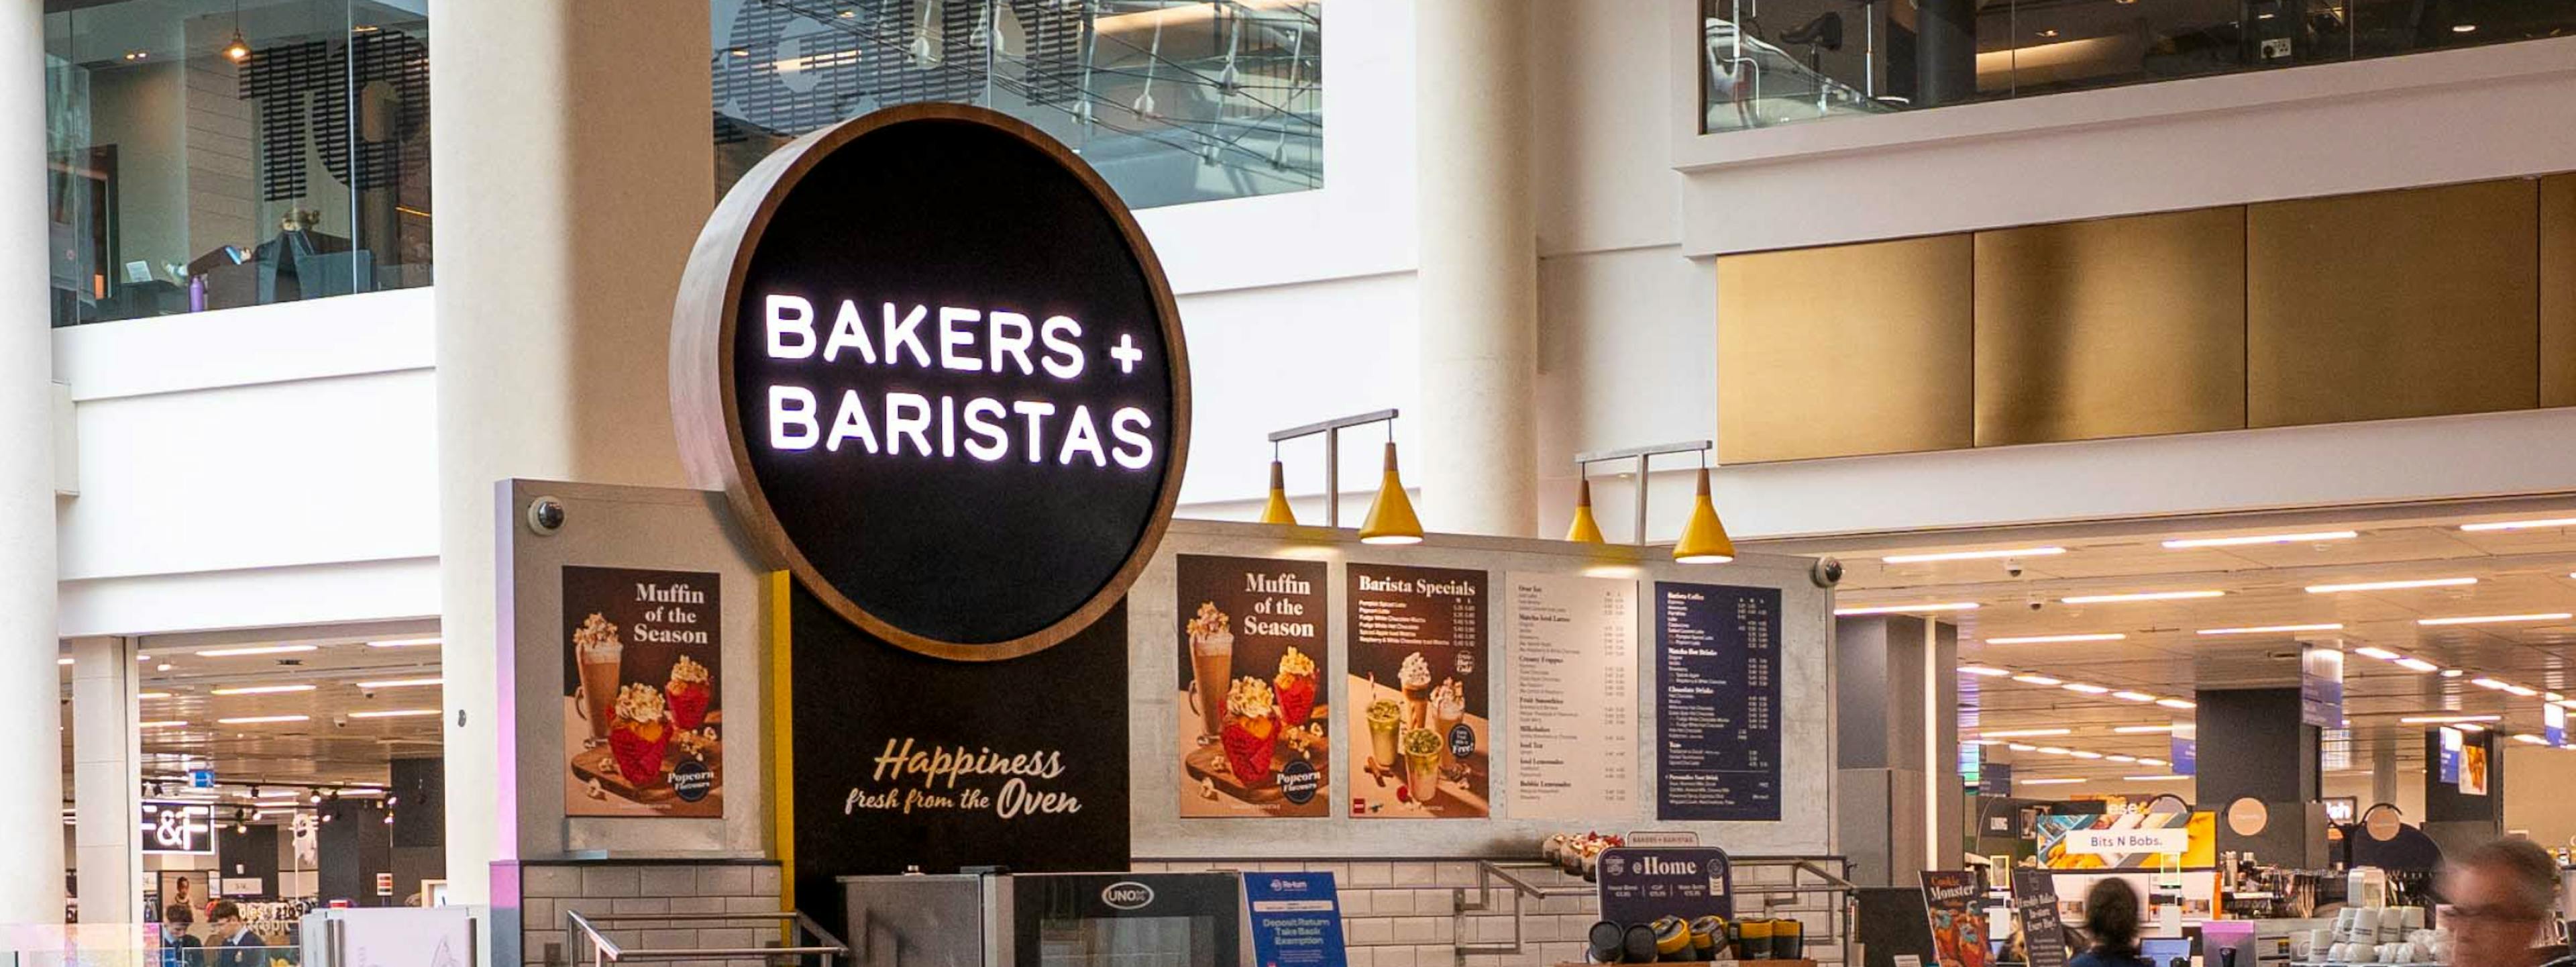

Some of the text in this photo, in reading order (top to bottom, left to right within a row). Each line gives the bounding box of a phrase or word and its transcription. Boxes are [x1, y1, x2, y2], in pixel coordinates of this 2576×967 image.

[765, 294, 1144, 380] BAKERS +
[767, 385, 1153, 471] BARISTAS
[637, 583, 704, 604] Muffin
[1245, 572, 1311, 595] Muffin
[1359, 575, 1476, 597] Barista Specials
[645, 607, 696, 623] of the
[1254, 597, 1303, 615] of the
[634, 623, 708, 644] Season
[1244, 615, 1314, 638] Season
[873, 737, 1065, 788] Happiness
[667, 770, 714, 784] Popcorn
[1277, 770, 1321, 786] Popcorn
[845, 778, 1082, 819] fresh from the Oven
[2091, 835, 2162, 847] Bits N Bobs.
[1108, 889, 1147, 902] UNOX
[1930, 884, 1975, 901] Monster
